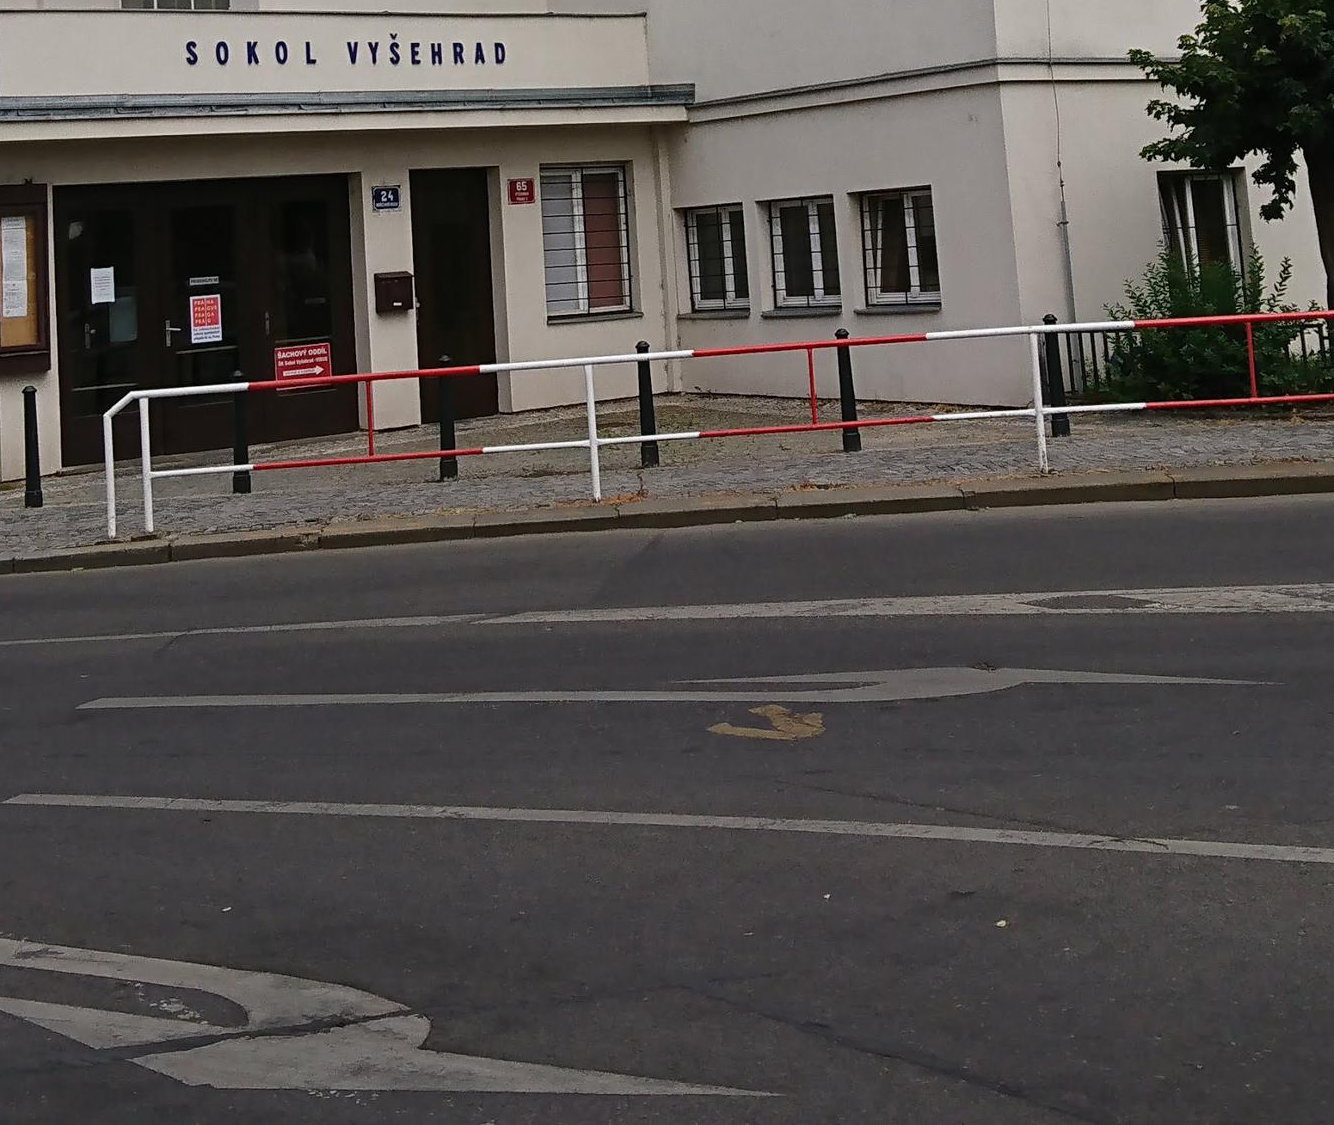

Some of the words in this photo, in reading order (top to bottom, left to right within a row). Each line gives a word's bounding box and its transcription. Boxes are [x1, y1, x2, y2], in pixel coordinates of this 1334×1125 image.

[185, 41, 317, 65] SOKOL
[346, 33, 506, 65] VYŠEHRAD
[516, 181, 528, 191] 65
[380, 190, 394, 202] 24
[277, 348, 307, 359] ŠACHOVÝ
[308, 346, 327, 356] ODDÍL
